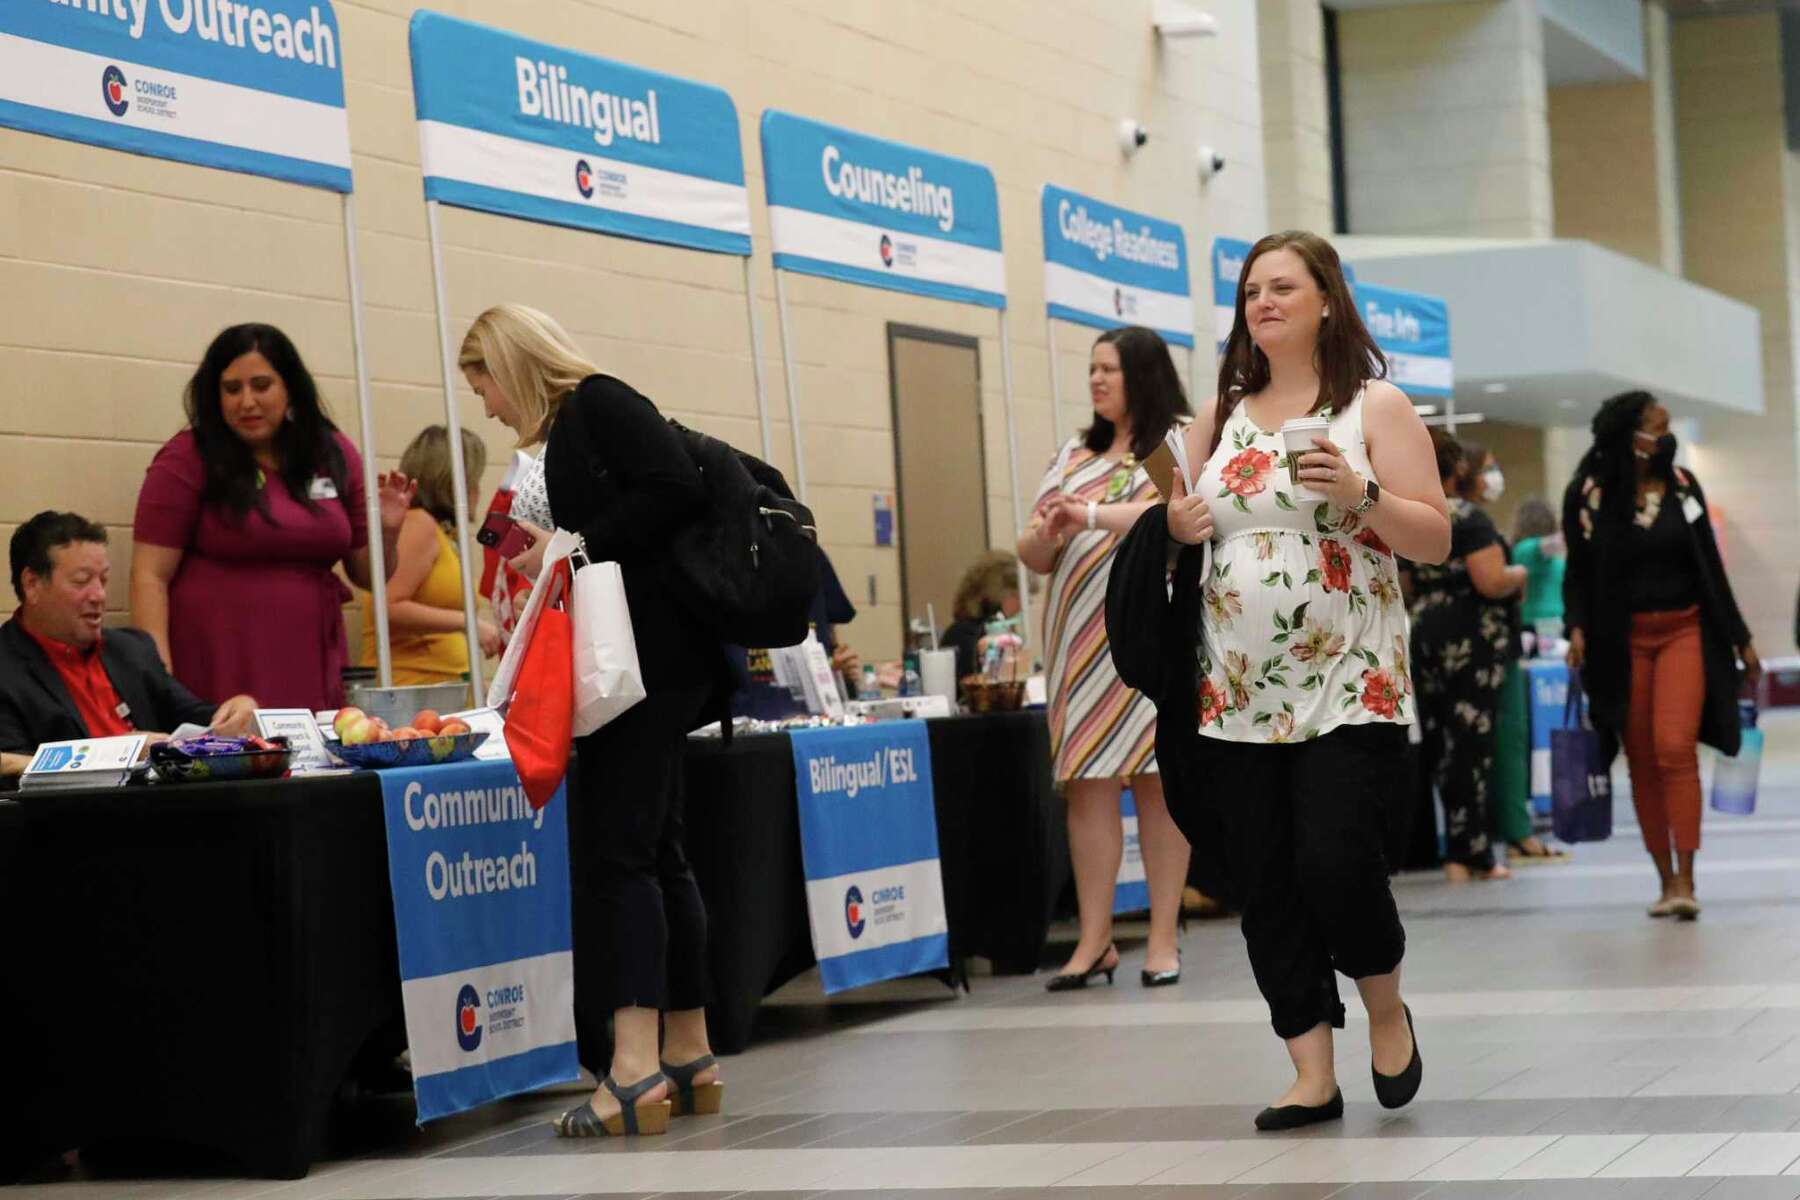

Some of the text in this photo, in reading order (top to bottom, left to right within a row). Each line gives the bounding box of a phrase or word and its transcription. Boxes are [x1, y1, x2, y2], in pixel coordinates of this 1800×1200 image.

[158, 0, 337, 68] Outreach
[134, 79, 177, 100] CONROE
[515, 56, 660, 146] Bilingual
[822, 145, 954, 232] Counseling
[1058, 199, 1113, 262] College
[1113, 218, 1179, 270] Readiness
[809, 747, 918, 797] Bilingual/ESL
[425, 841, 536, 900] Outreach
[486, 984, 524, 1008] CONROE
